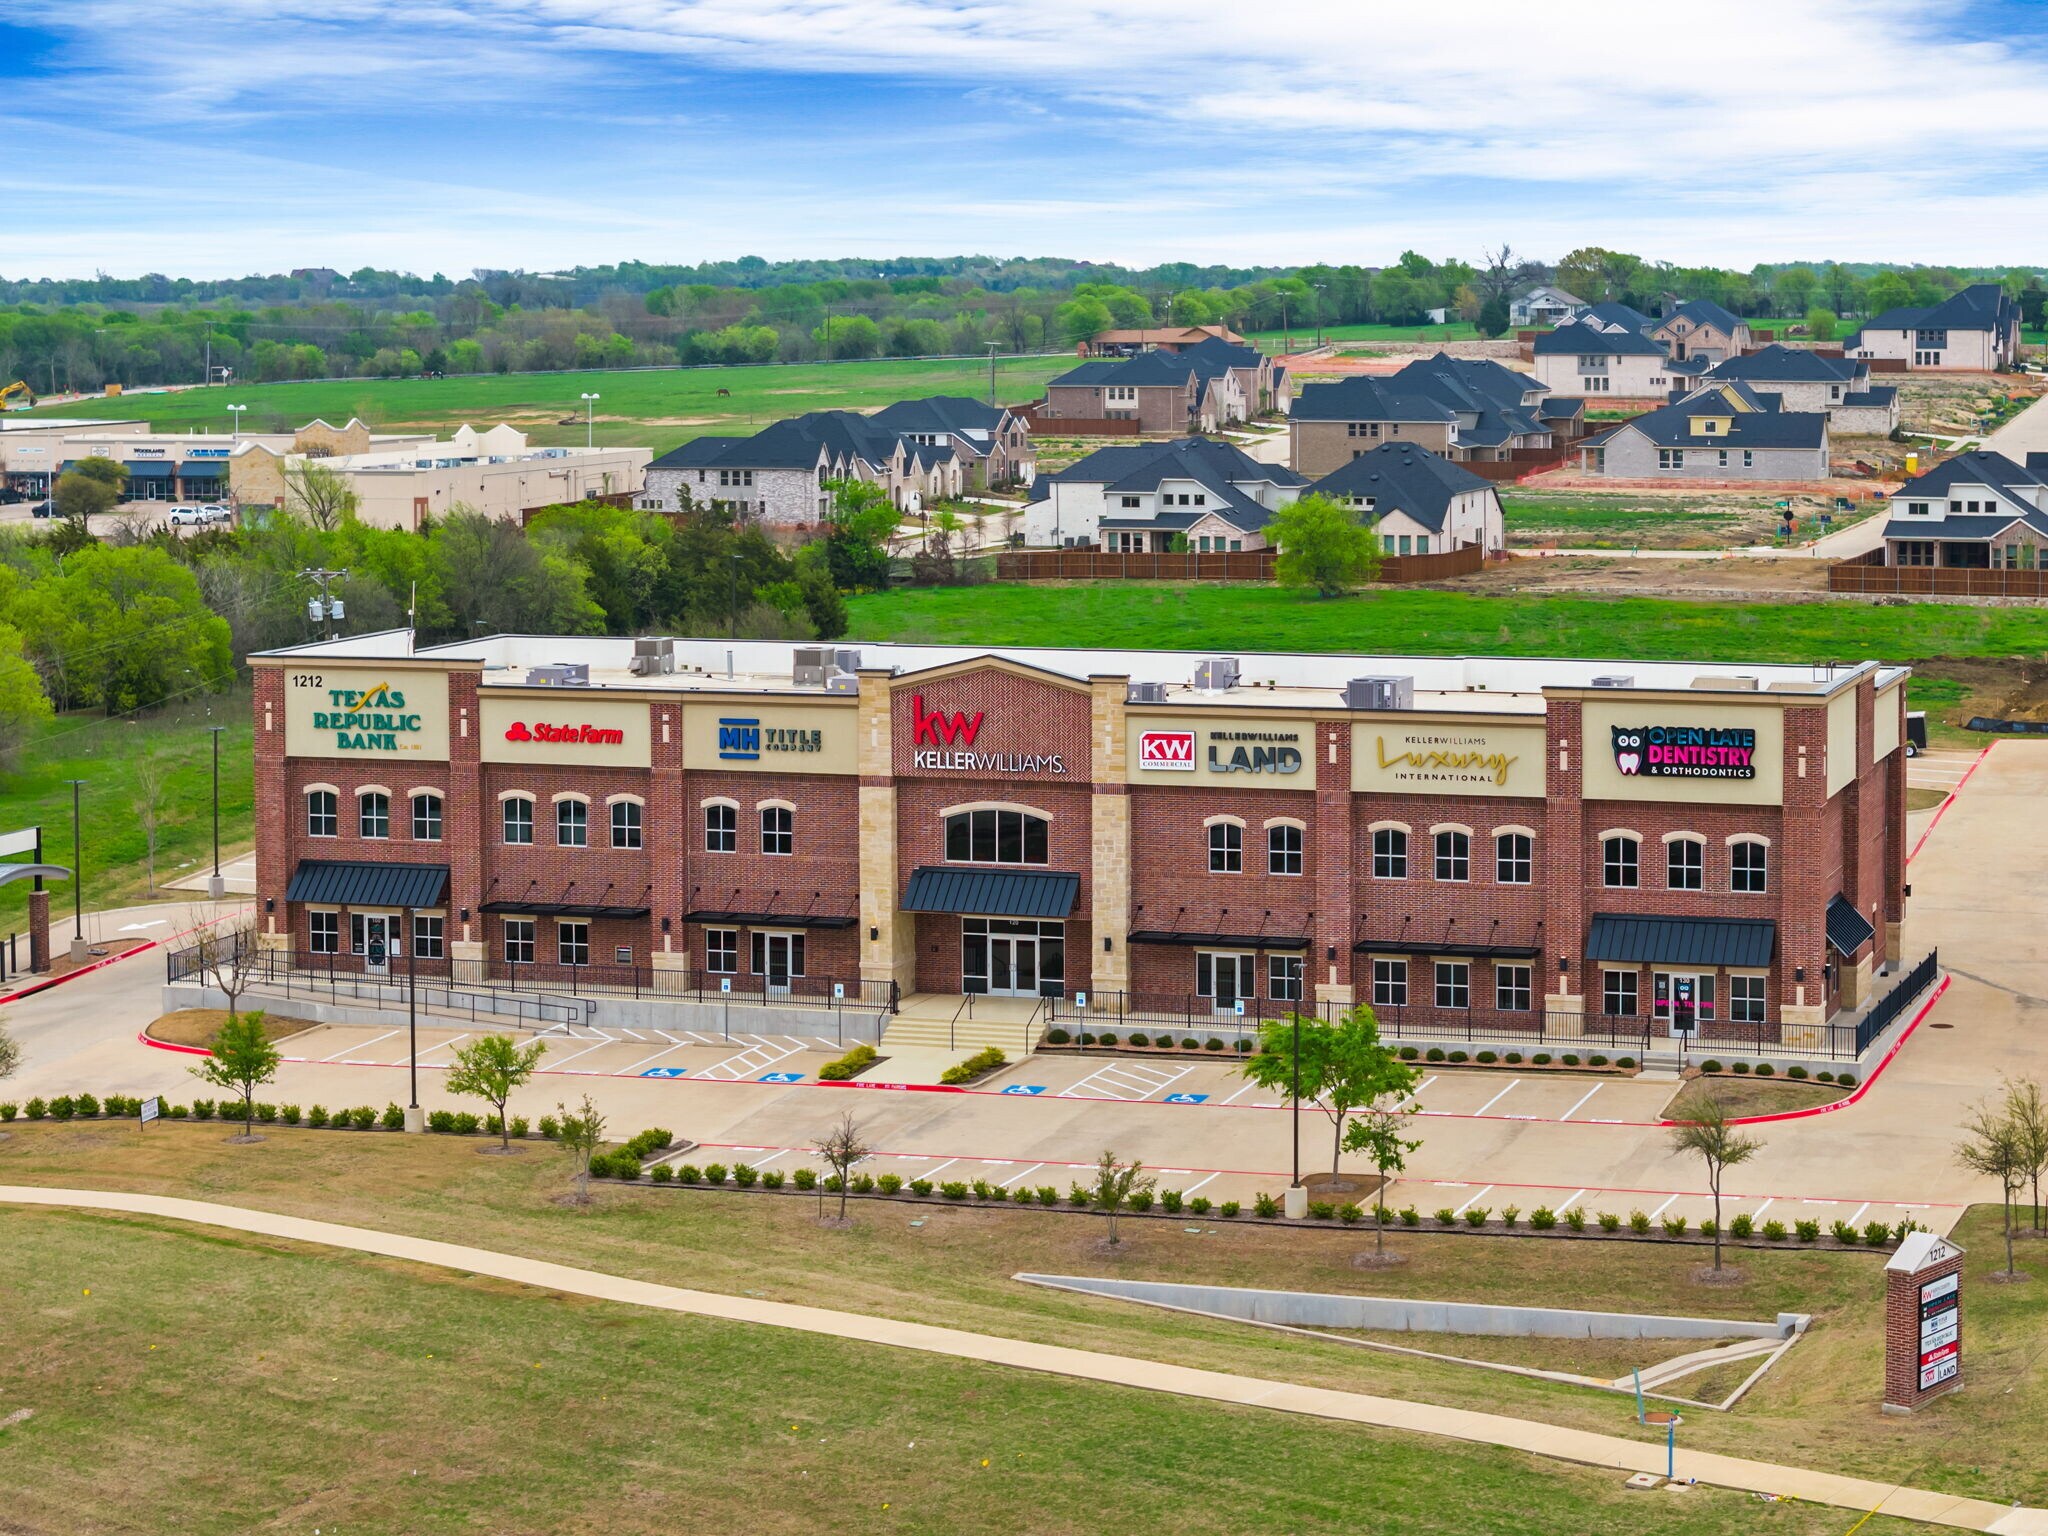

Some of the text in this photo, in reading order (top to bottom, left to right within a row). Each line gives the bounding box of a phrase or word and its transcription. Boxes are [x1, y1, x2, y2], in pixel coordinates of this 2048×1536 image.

[292, 675, 323, 688] 1212
[328, 689, 406, 709] TEXAS
[313, 712, 421, 732] REPUBLIC
[337, 731, 398, 751] BANK
[719, 727, 822, 751] MH TITLE
[1649, 726, 1753, 747] OPEN LATE
[765, 743, 822, 752] COMPANY
[1142, 738, 1191, 760] KW
[1648, 745, 1753, 767] DENTISTRY
[1208, 745, 1303, 774] LAND
[1377, 735, 1519, 786] Luxury
[1395, 772, 1493, 783] INTERNATIONAL
[1651, 766, 1752, 778] & ORTHODONTICS
[1929, 1246, 1946, 1262] 1212
[1940, 1365, 1956, 1379] LAND
